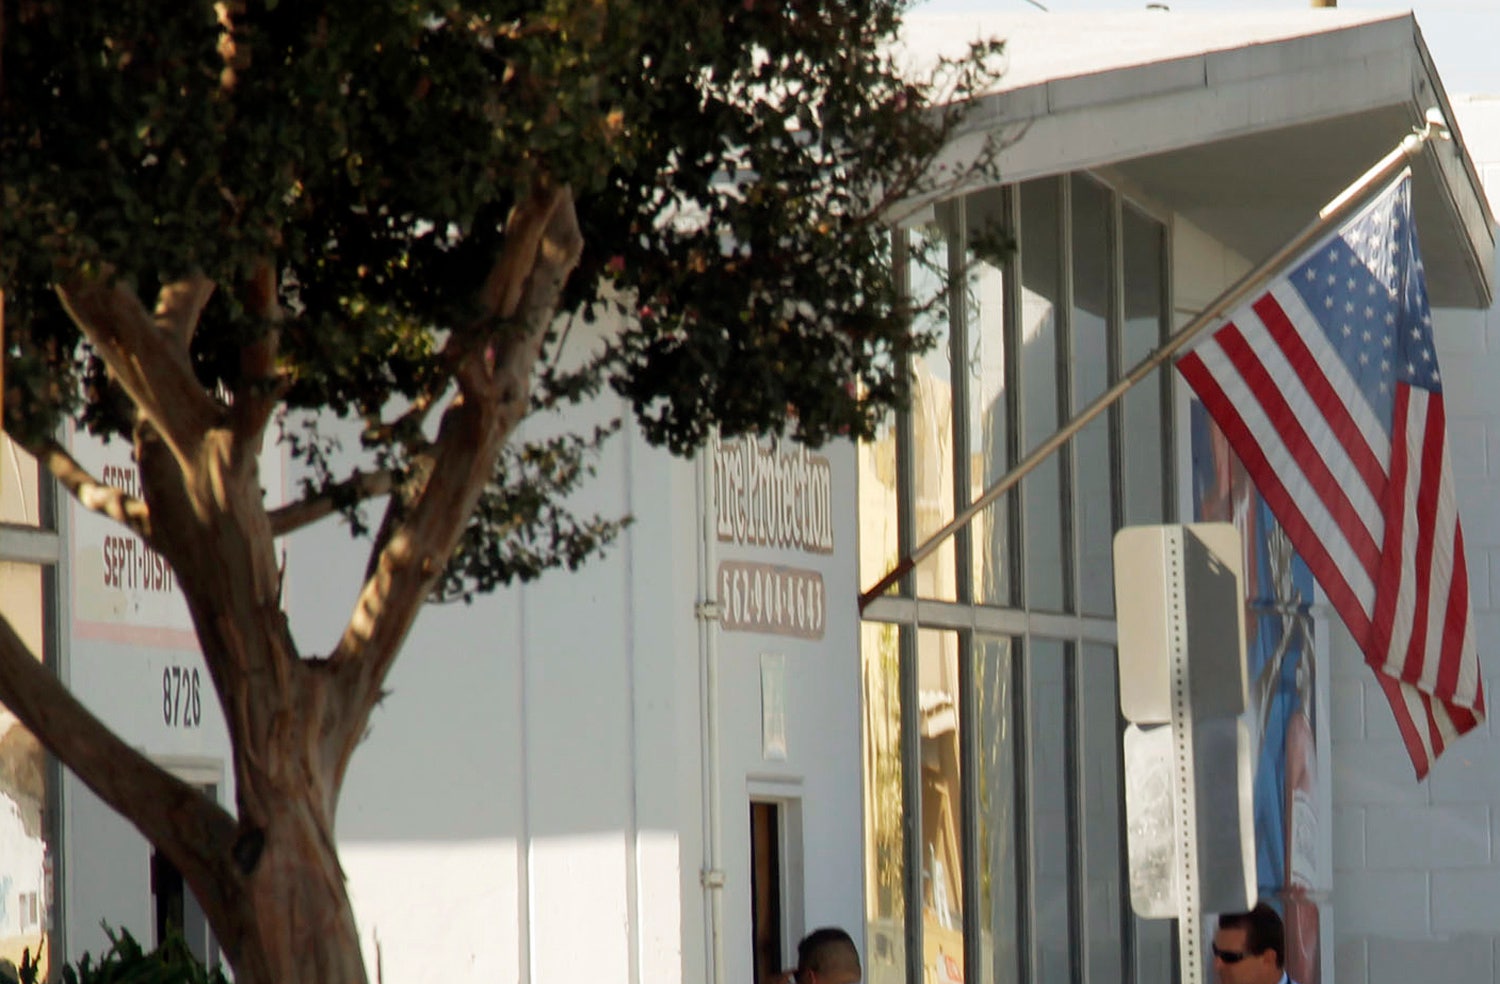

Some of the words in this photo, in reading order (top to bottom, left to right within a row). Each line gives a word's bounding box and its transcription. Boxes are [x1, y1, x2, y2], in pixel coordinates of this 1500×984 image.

[713, 428, 745, 546] ire
[746, 431, 834, 555] Protection
[163, 666, 201, 728] 8726
